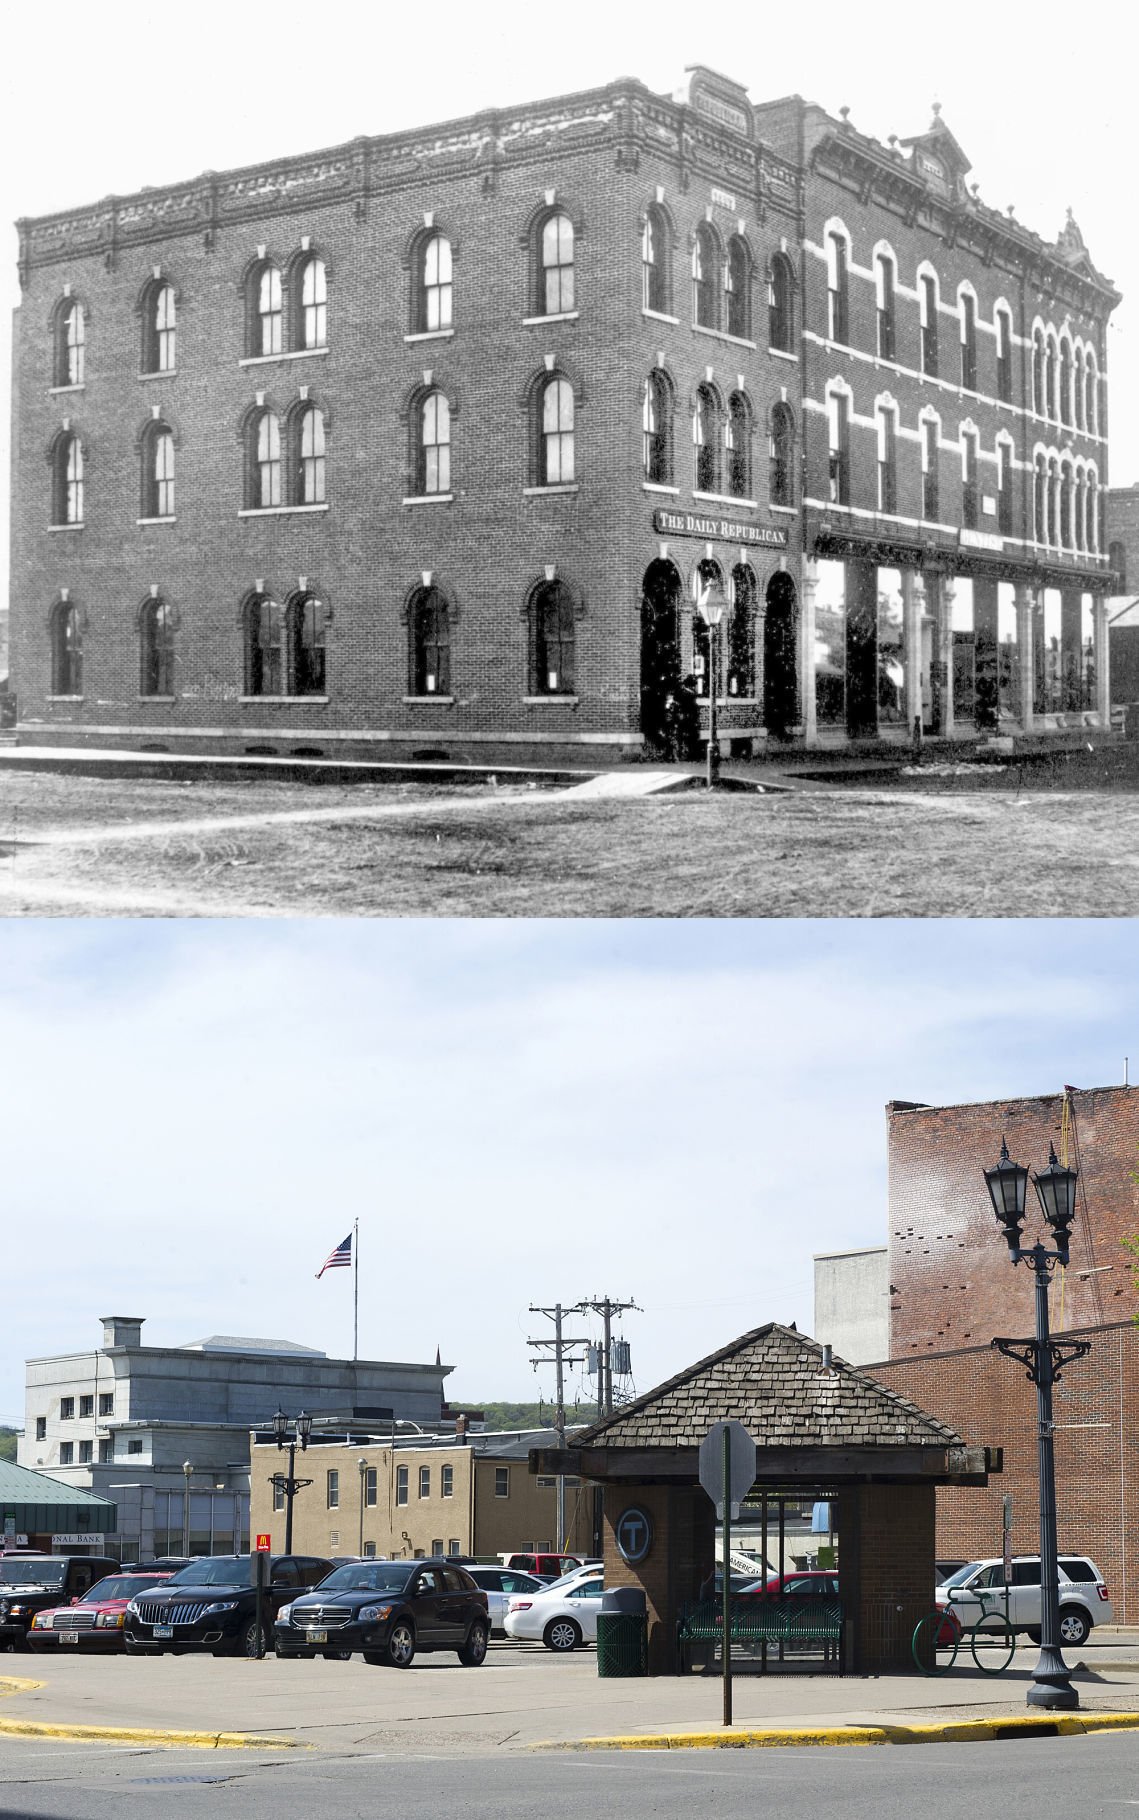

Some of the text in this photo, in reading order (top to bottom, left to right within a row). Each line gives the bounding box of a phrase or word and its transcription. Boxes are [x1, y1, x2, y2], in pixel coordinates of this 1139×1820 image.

[660, 512, 685, 529] THE
[687, 516, 719, 534] DAILY
[77, 1534, 101, 1543] BANK
[623, 1521, 643, 1552] T
